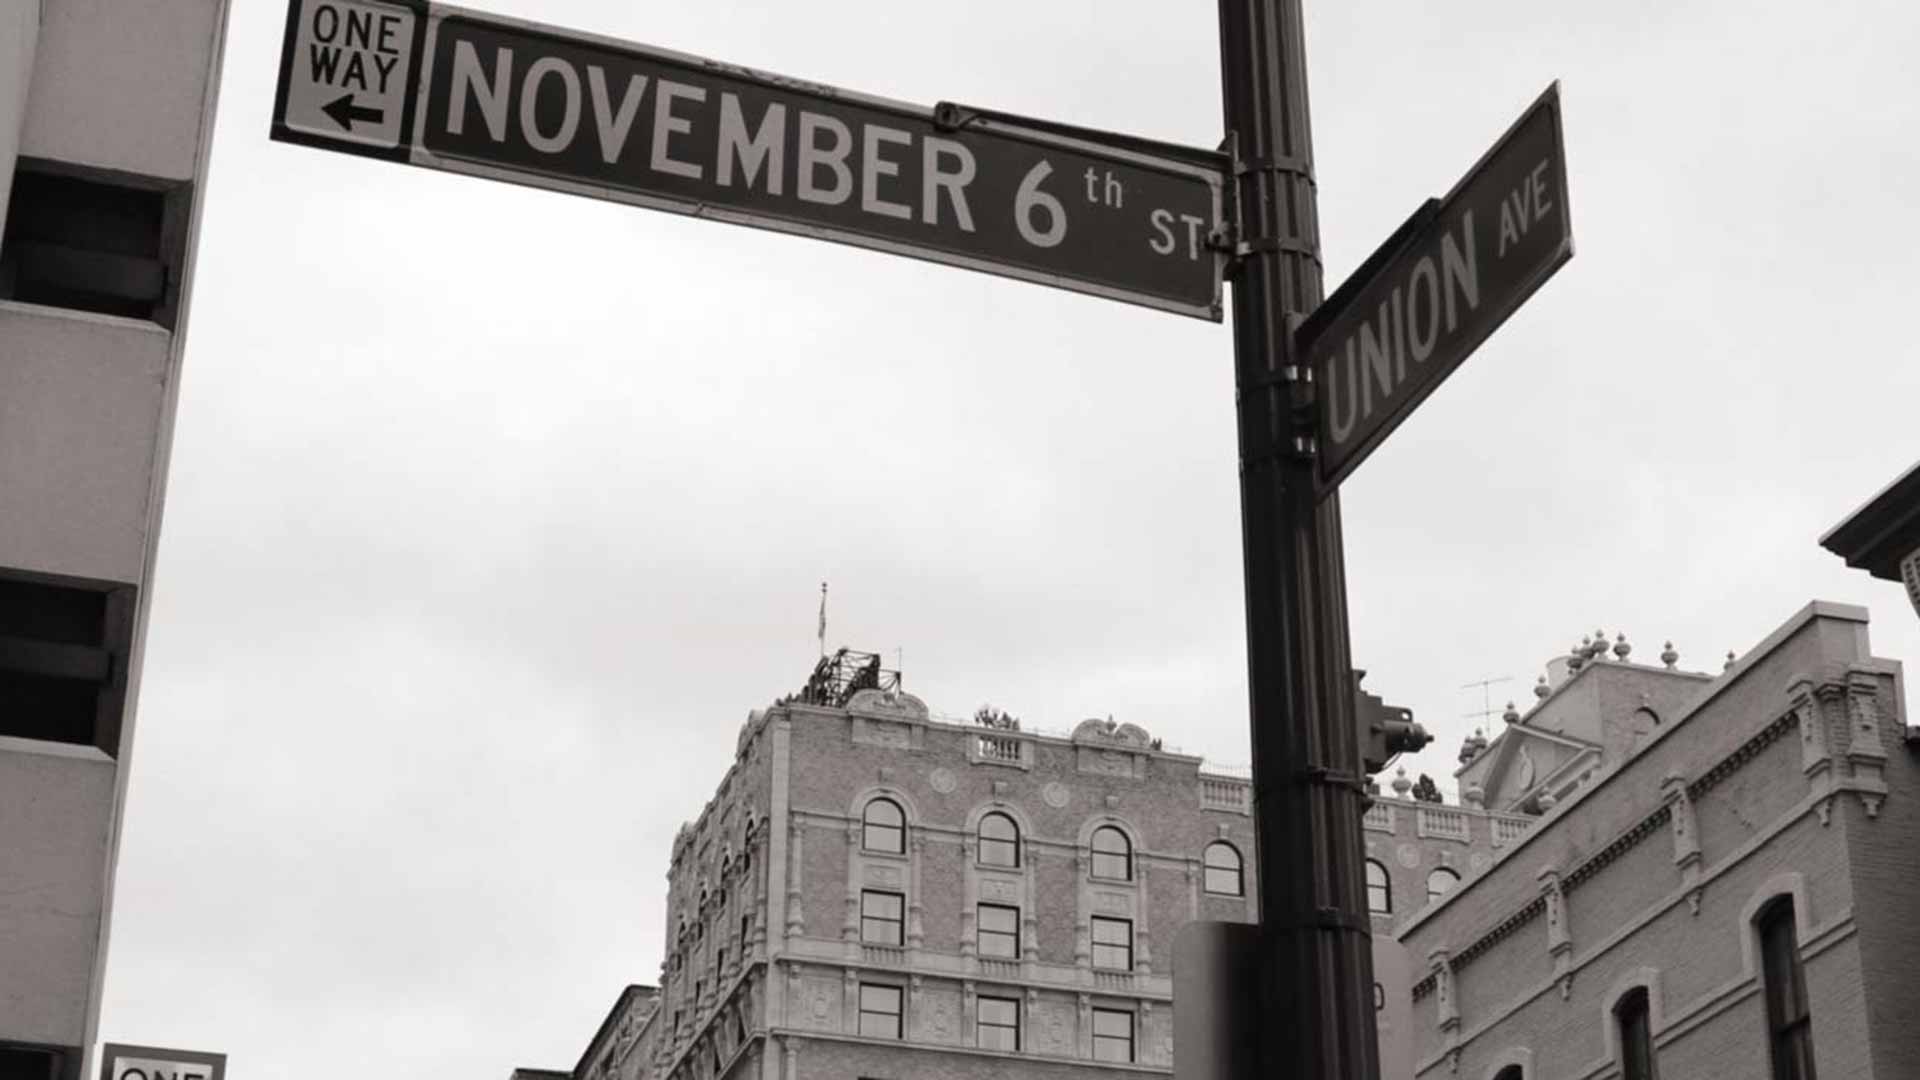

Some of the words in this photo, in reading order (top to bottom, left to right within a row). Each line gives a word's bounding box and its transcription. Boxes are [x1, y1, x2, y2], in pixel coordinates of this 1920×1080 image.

[310, 43, 399, 94] WAY
[313, 4, 401, 55] ONE
[445, 38, 978, 234] NOVEMBER
[1148, 208, 1204, 261] ST
[1326, 207, 1481, 444] UNION
[1499, 157, 1554, 258] AVE
